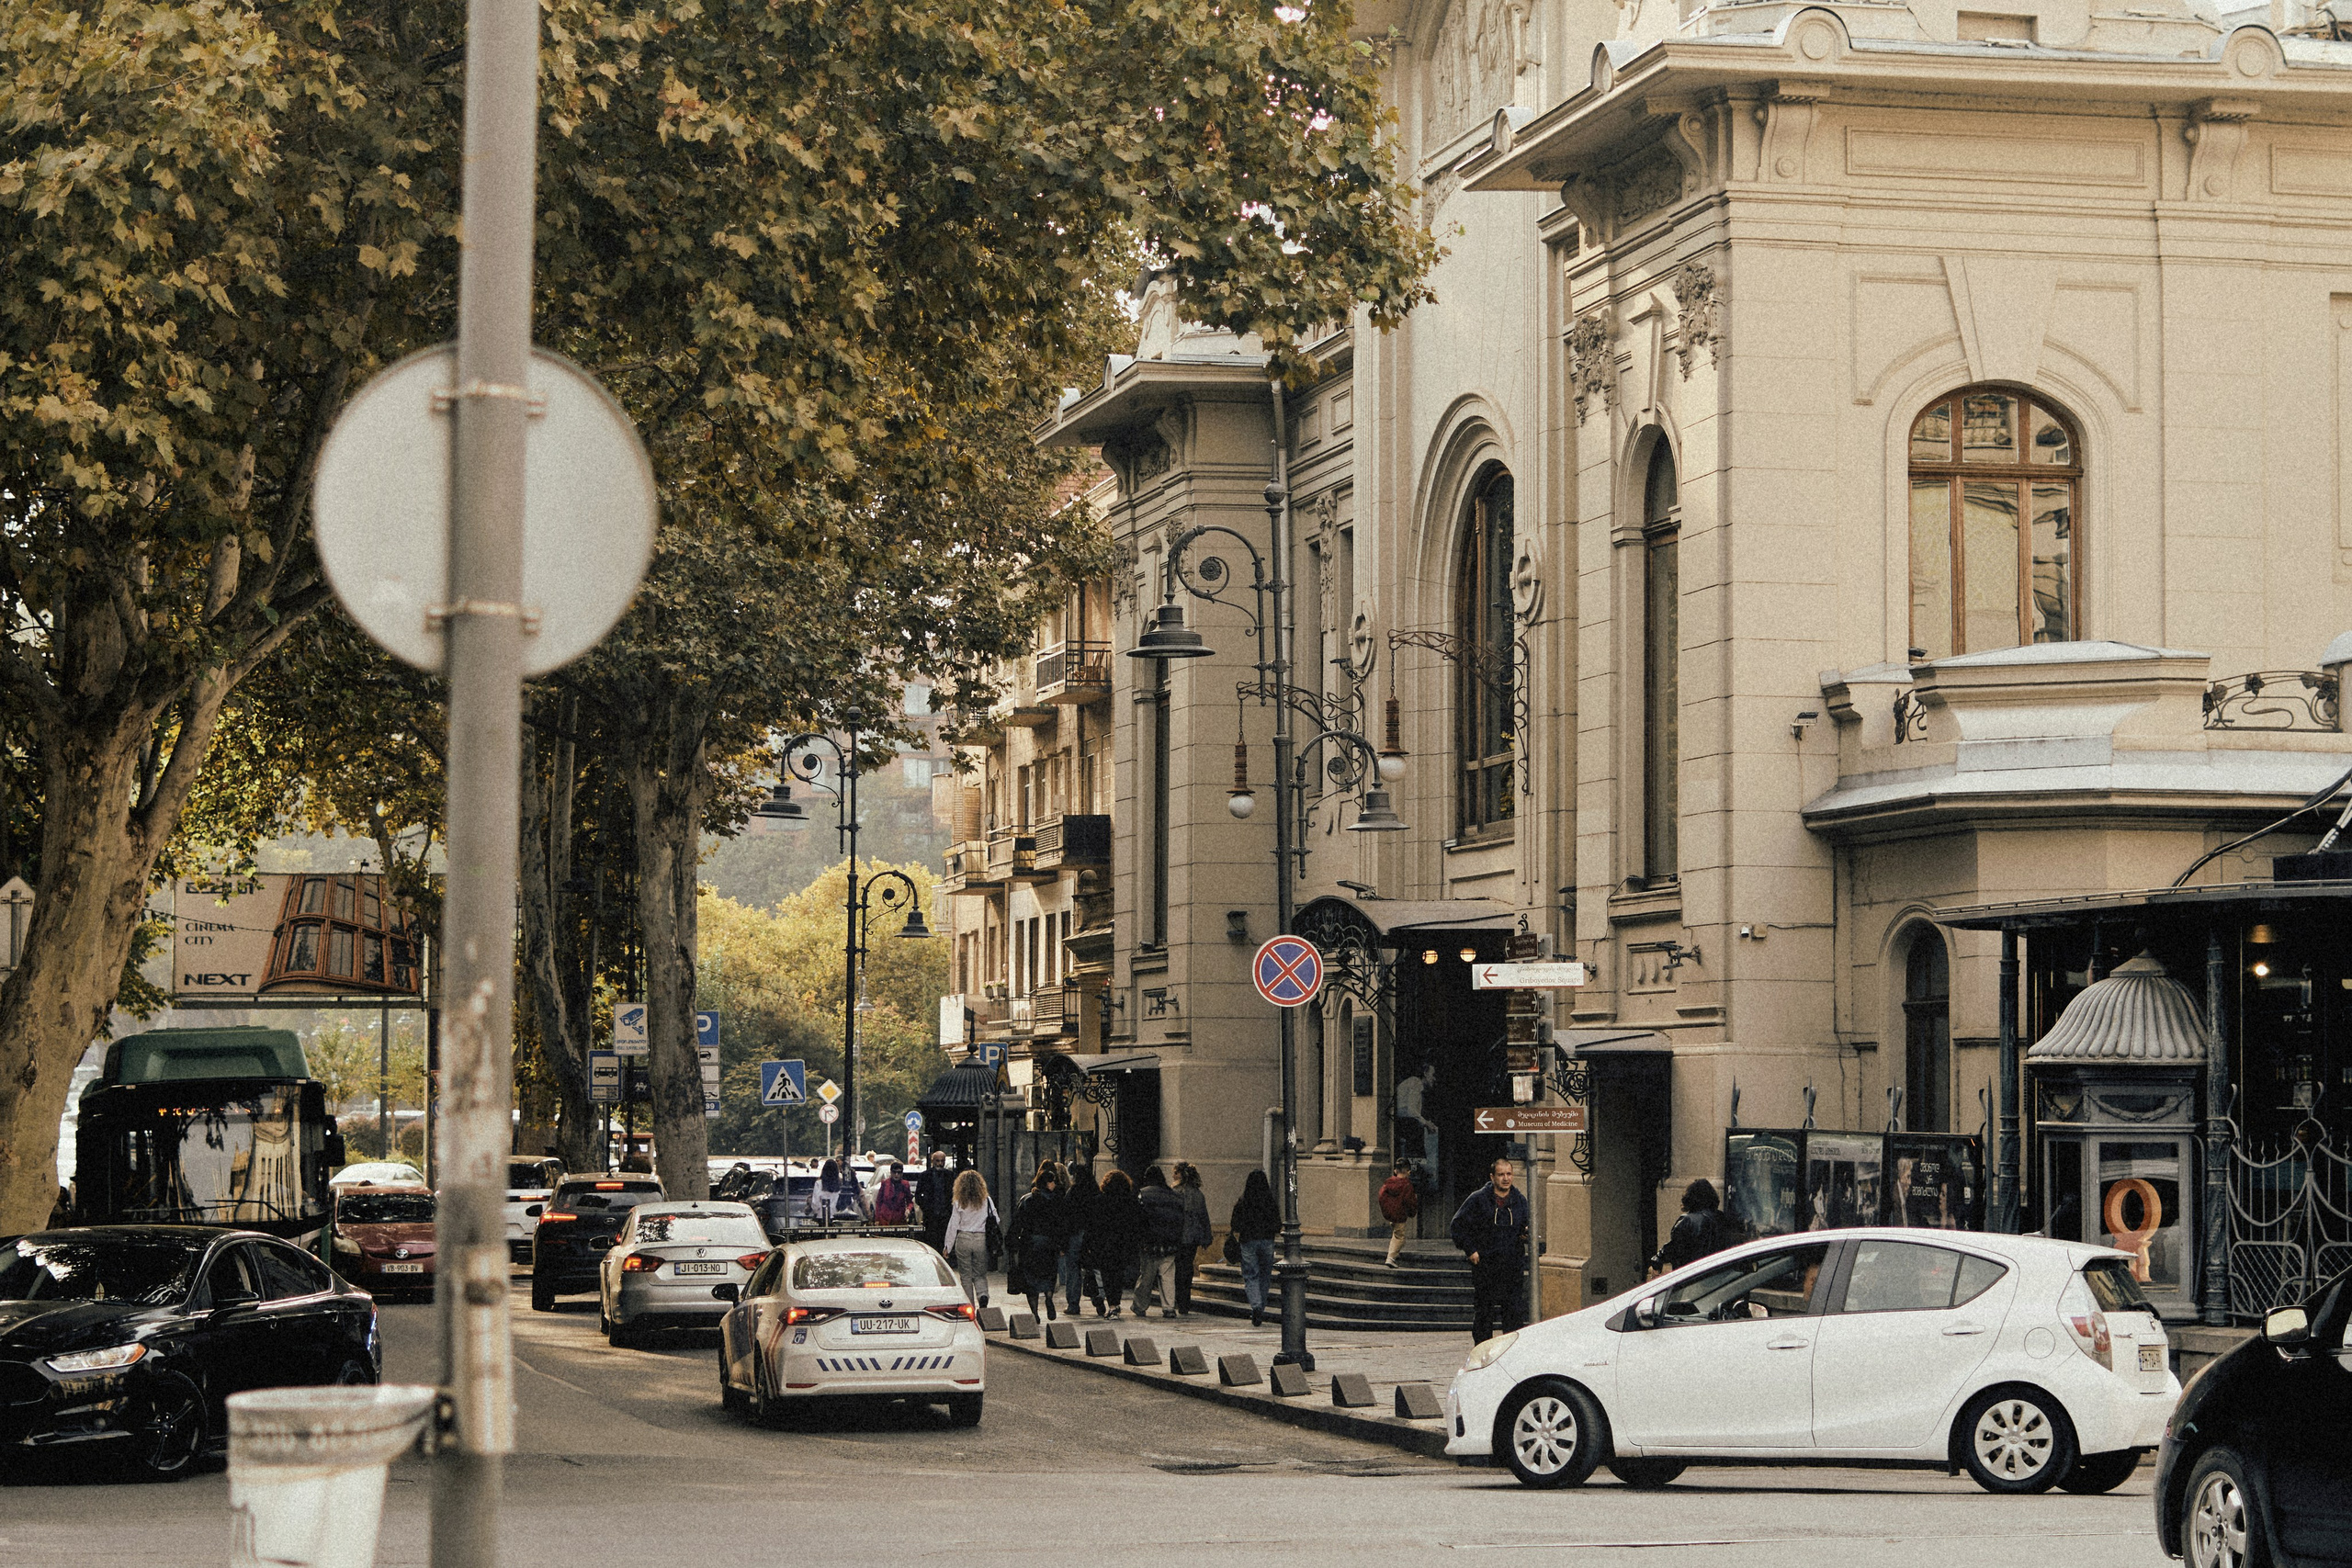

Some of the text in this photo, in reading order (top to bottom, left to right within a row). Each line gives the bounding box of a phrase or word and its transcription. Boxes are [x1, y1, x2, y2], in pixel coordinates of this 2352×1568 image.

[186, 922, 235, 932] CINEMA
[185, 936, 214, 945] CITY
[184, 974, 253, 987] NEXT
[1519, 976, 1581, 985] Griboyedov Square
[1517, 1111, 1579, 1119] მედიცინის მუზეუმი
[681, 1264, 721, 1273] JI-013-NO
[860, 1319, 910, 1330] UU-217-UK
